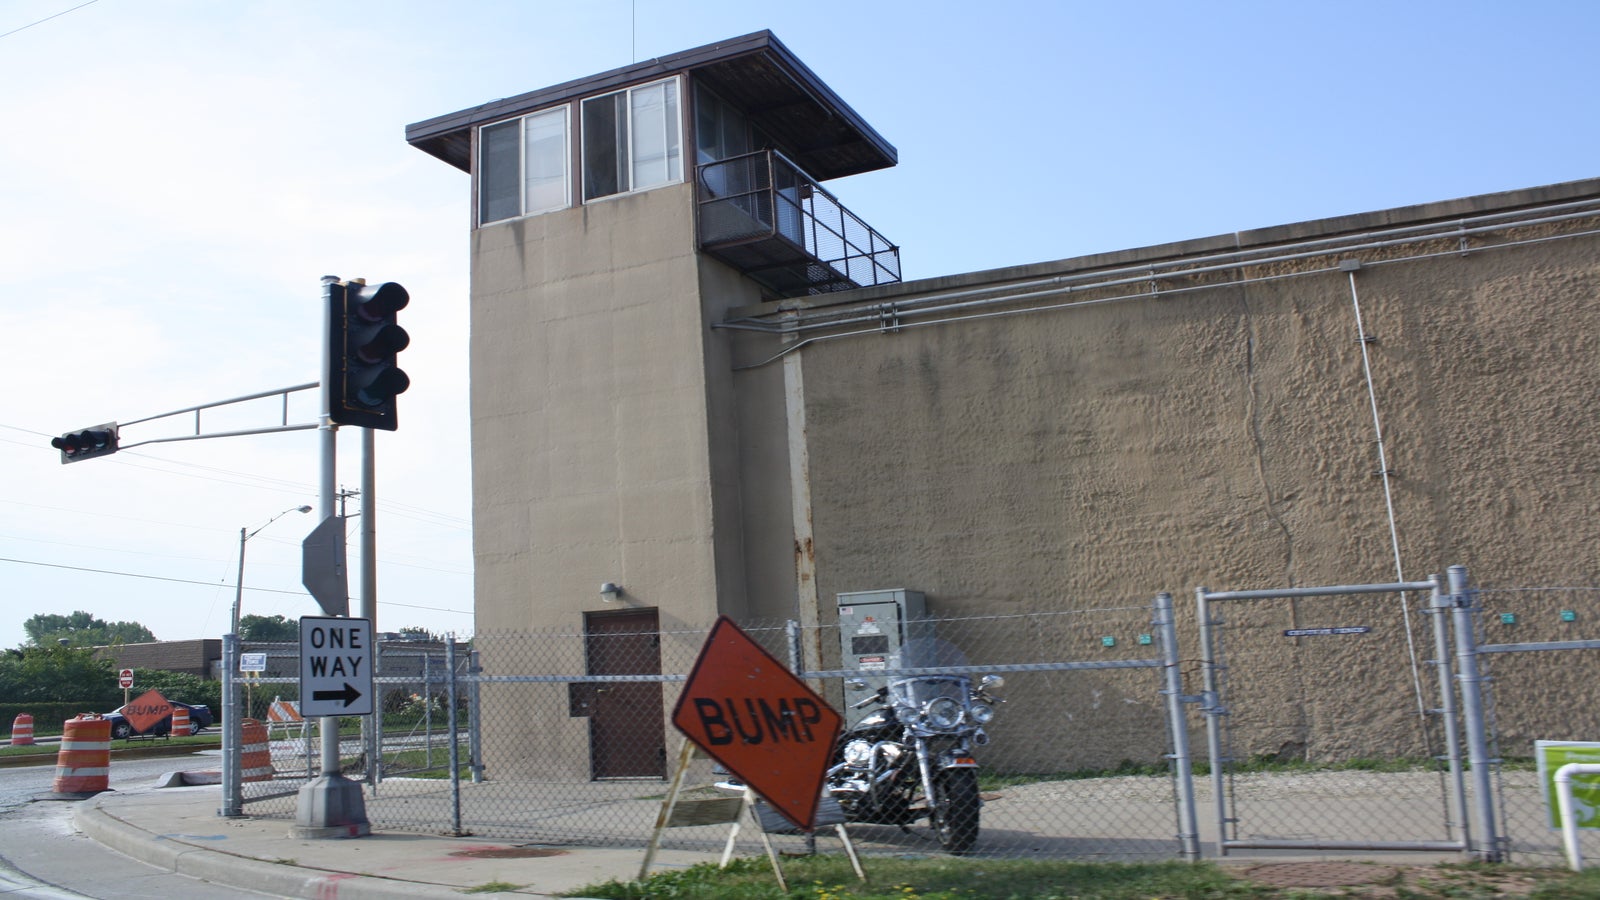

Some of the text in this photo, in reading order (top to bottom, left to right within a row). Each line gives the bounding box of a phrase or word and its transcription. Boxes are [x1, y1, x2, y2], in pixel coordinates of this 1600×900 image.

[311, 627, 362, 649] ONE
[310, 656, 362, 677] WAY
[126, 704, 169, 716] BUMP
[693, 697, 821, 746] BUMP
